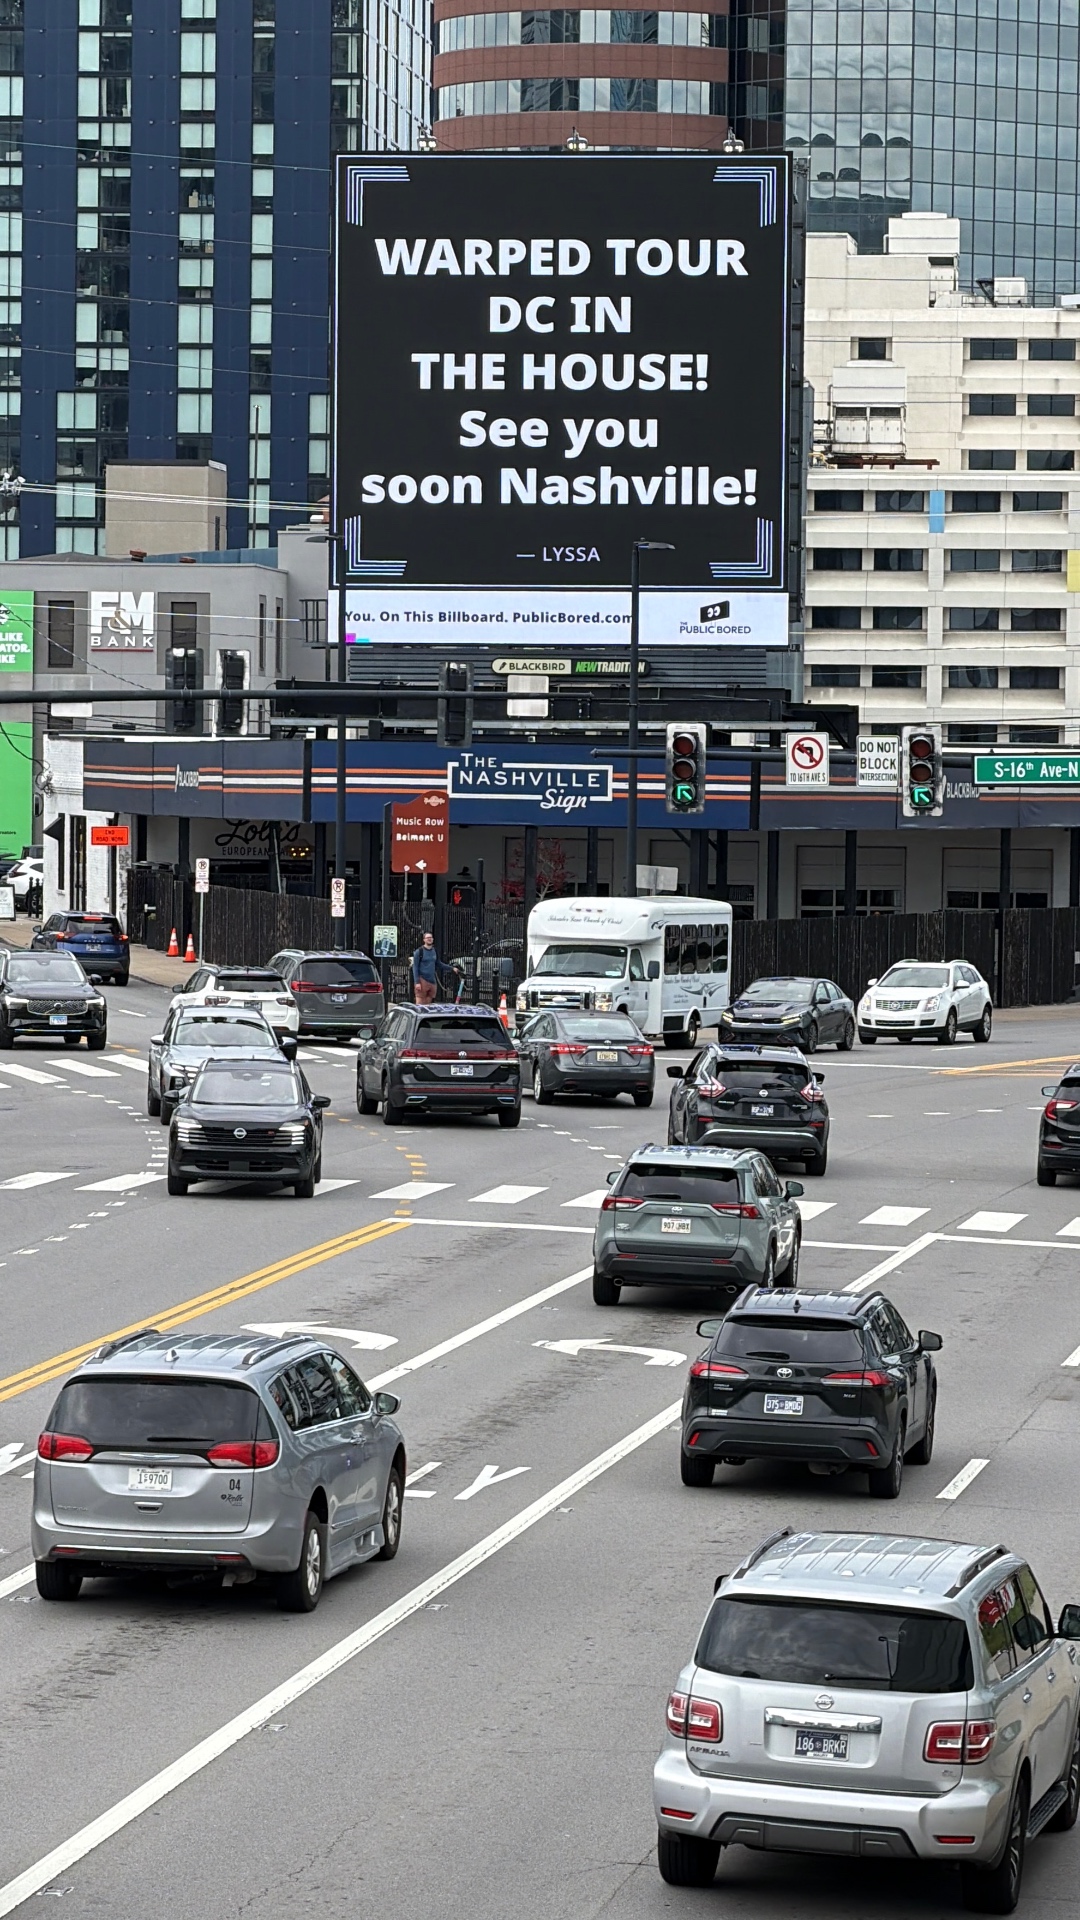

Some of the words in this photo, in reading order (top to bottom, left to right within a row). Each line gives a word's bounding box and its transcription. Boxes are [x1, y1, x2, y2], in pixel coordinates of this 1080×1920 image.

[375, 238, 591, 276] WARPED
[607, 238, 748, 276] TOUR
[490, 296, 555, 333] DC
[571, 297, 631, 333] IN
[411, 353, 505, 389] THE
[523, 353, 708, 391] HOUSE!
[460, 410, 548, 447] See
[563, 418, 657, 458] you
[362, 474, 482, 504] soon
[501, 466, 756, 505] Nashville!
[543, 547, 600, 562] LYSSA
[91, 591, 154, 634] F&M
[345, 611, 376, 622] You.
[380, 611, 399, 622] On
[404, 611, 434, 622] This
[438, 611, 508, 623] Billboard.
[513, 611, 632, 624] PublicBored.com
[680, 625, 715, 634] PUBLIC
[717, 626, 752, 634] BORED
[0, 643, 31, 653] ATOR.
[91, 636, 153, 647] BANK
[509, 662, 566, 671] BLACKBIRD
[576, 661, 645, 672] NEWTRADITN
[860, 741, 873, 753] DO
[877, 741, 897, 753] NOT
[460, 752, 497, 768] THE
[860, 758, 897, 770] BLOCK
[1040, 761, 1078, 778] Ave-N
[460, 770, 601, 788] NASHVILLE
[790, 773, 797, 782] TO
[811, 773, 820, 782] AVE
[821, 773, 826, 782] S
[860, 772, 897, 781] INTERSECTION
[540, 788, 587, 813] Sign
[396, 817, 422, 826] Music
[425, 817, 444, 826] Row
[396, 833, 434, 841] Belmont
[437, 834, 444, 842] U
[222, 847, 269, 856] EUROPEAN
[229, 1479, 241, 1490] 04
[796, 1736, 814, 1751] 186
[822, 1738, 846, 1754] BRKR
